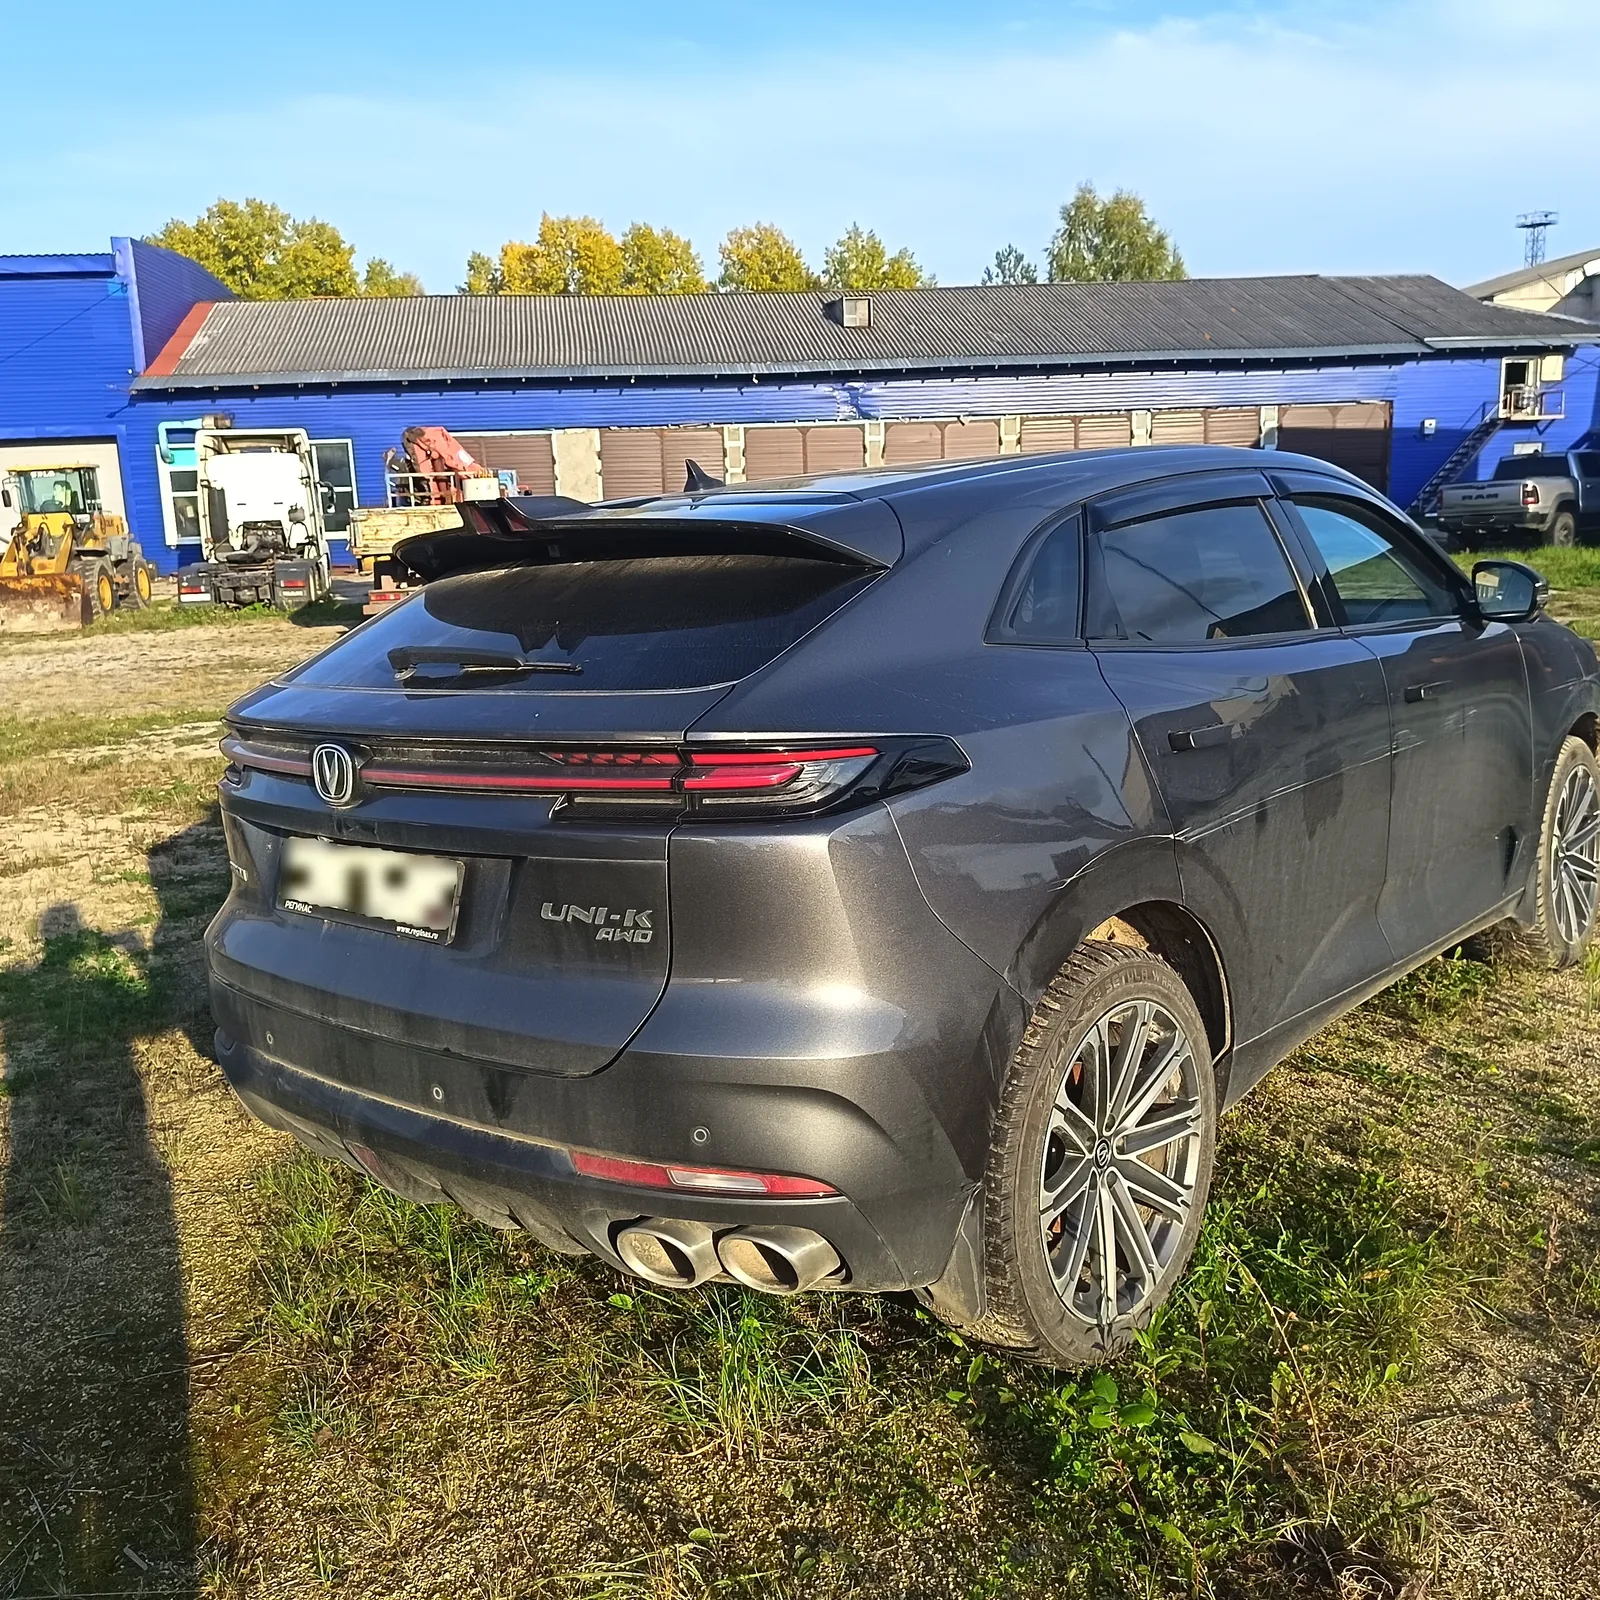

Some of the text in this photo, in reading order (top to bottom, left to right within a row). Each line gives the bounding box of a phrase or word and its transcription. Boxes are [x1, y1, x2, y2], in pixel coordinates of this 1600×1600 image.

[1462, 493, 1498, 501] RAM
[284, 900, 313, 914] РЕГИНАС
[540, 902, 653, 928] UNI-K
[595, 927, 653, 943] AWD
